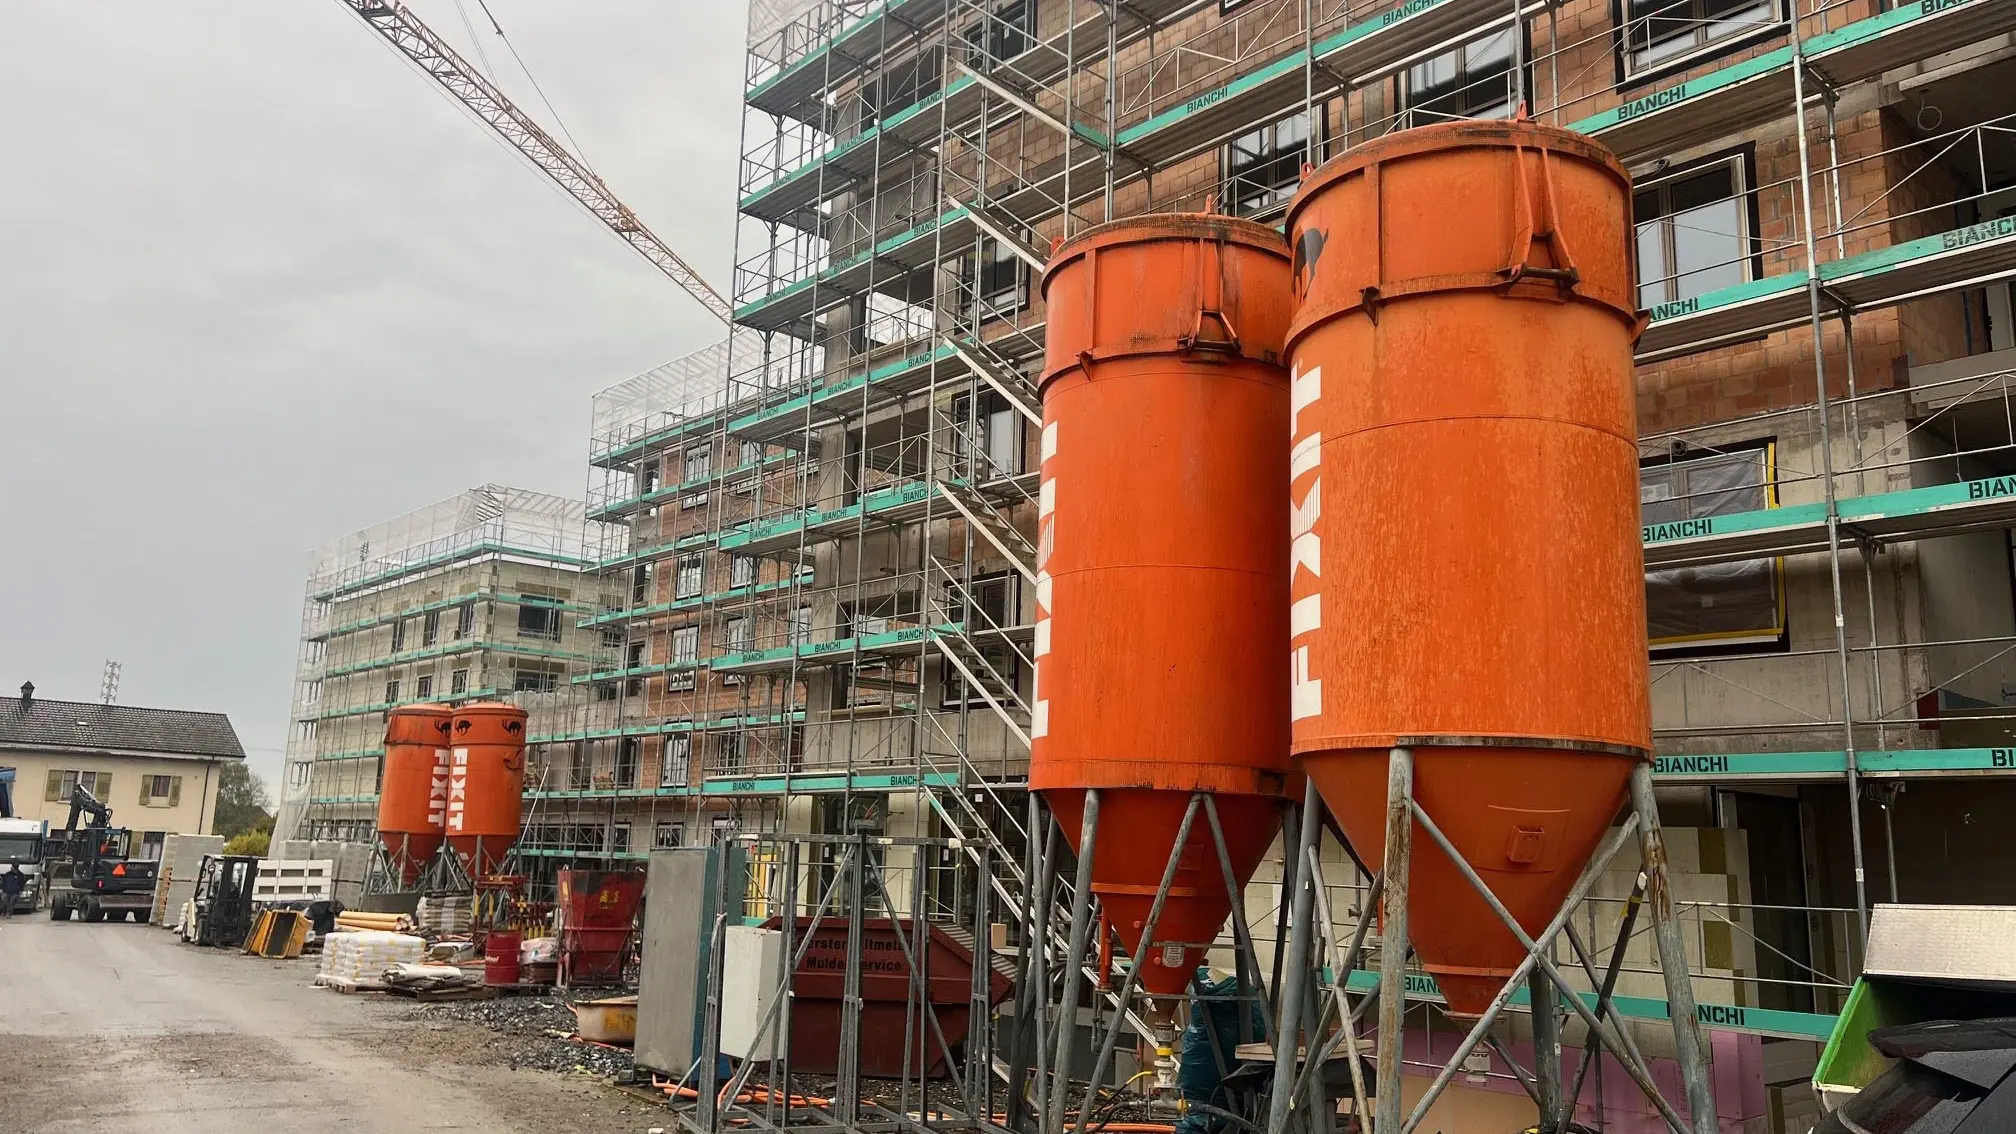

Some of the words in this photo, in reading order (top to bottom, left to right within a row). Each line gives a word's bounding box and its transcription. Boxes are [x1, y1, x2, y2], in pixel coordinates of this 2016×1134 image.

[1186, 87, 1228, 113] BIANCHI
[1618, 84, 1686, 120] BIANCHI
[1943, 216, 2016, 249] BIANC
[828, 380, 852, 396] BIANCHI
[822, 508, 847, 522] BIANCHI
[1290, 363, 1322, 723] FIXIT
[1643, 519, 1712, 541] BIANCHI
[815, 641, 841, 653] BIANCHI
[1654, 756, 1728, 773] BIANCHI
[428, 749, 450, 827] FIXIT
[448, 748, 468, 831] FIXIT
